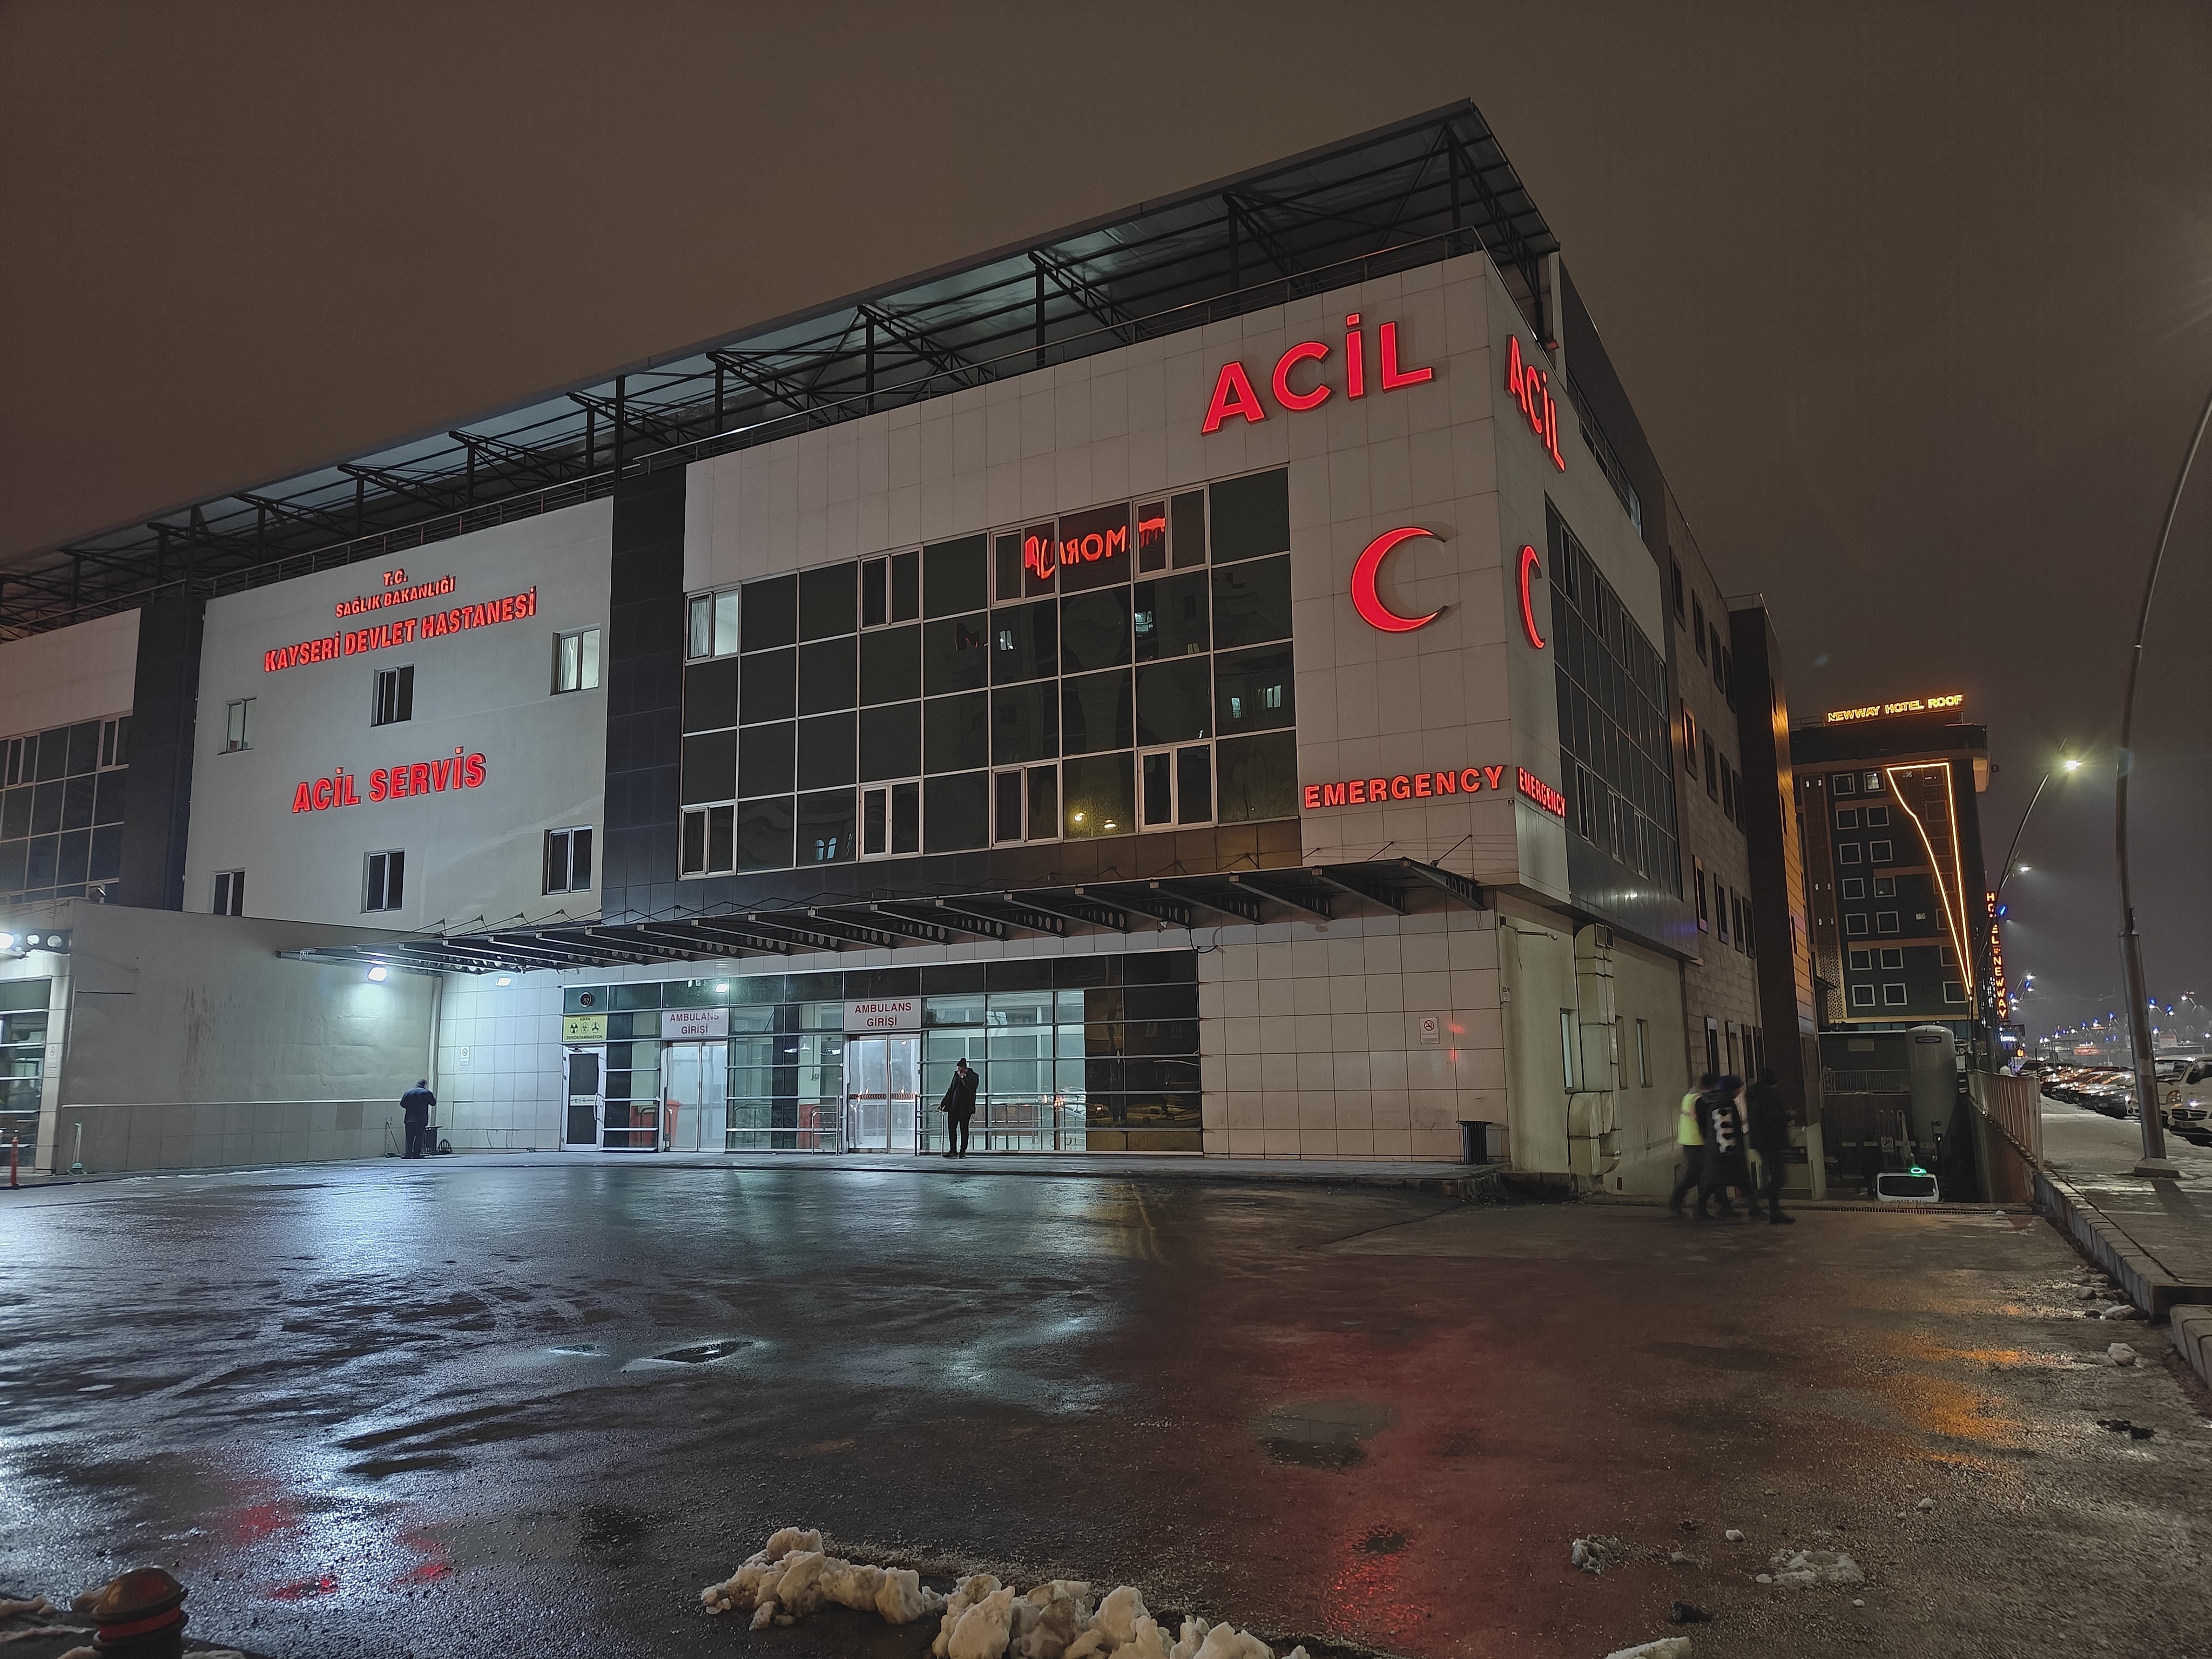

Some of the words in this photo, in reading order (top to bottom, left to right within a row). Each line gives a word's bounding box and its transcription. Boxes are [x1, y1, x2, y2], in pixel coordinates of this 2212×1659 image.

[1201, 313, 1434, 436] ACİL
[1506, 334, 1566, 473] ACİL
[335, 595, 381, 618] SAĞLIK
[383, 576, 456, 607] BAKANLIĞI
[383, 569, 408, 586] T.C.
[264, 631, 340, 672] KAYSERİ
[344, 618, 416, 656] DEVLET
[421, 586, 538, 639] HASTANESİ
[1827, 705, 1881, 723] NEWWAY
[1885, 700, 1925, 714] HOTEL
[1927, 694, 1963, 709] ROOF
[292, 767, 361, 813] ACİL
[369, 746, 487, 802] SERVİS
[1304, 765, 1504, 809] EMERGENCY
[1516, 766, 1566, 818] EMERGENCY
[854, 1002, 912, 1014] AMBULANS
[1993, 956, 2007, 1019] NEWWAY
[670, 1011, 719, 1022] AMBULANS
[681, 1024, 708, 1035] GİRİŞİ
[867, 1015, 897, 1028] GİRİŞİ
